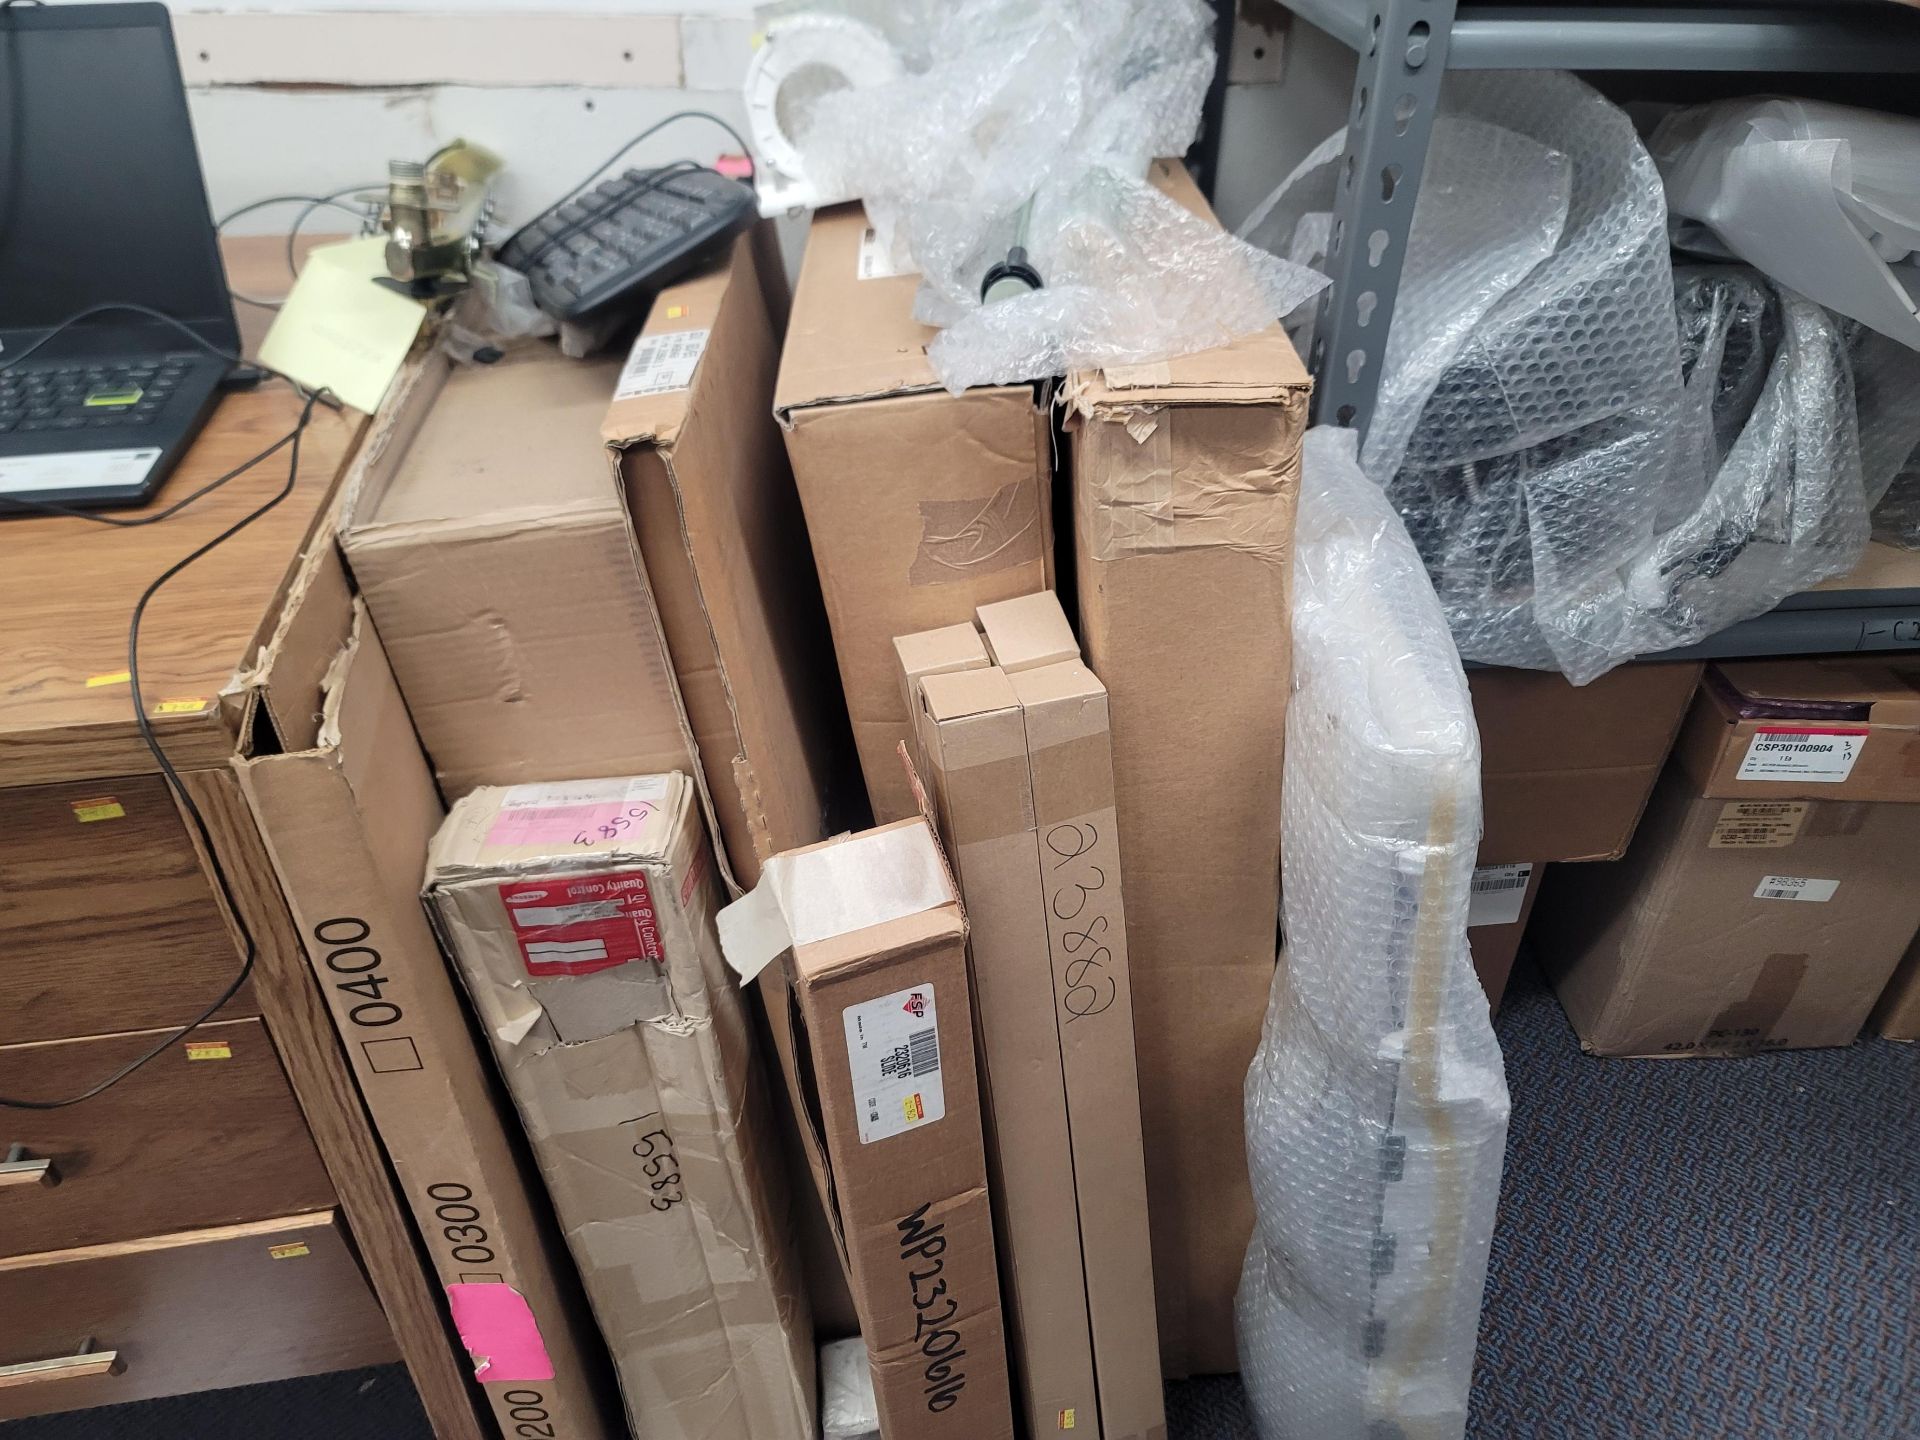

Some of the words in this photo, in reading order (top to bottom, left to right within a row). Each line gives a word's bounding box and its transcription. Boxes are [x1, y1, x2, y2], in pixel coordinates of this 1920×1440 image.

[1755, 743, 1833, 753] CSP30100904
[573, 801, 660, 847] 15583
[566, 883, 605, 898] Control
[314, 917, 403, 1026] 0400
[910, 992, 924, 1018] FSP
[880, 1055, 897, 1077] SLIDE
[894, 1044, 912, 1079] 2320616
[618, 1111, 683, 1211] 15583
[427, 1182, 495, 1264] 0300
[897, 1202, 966, 1413] WP2320616
[503, 1389, 556, 1440] 200
